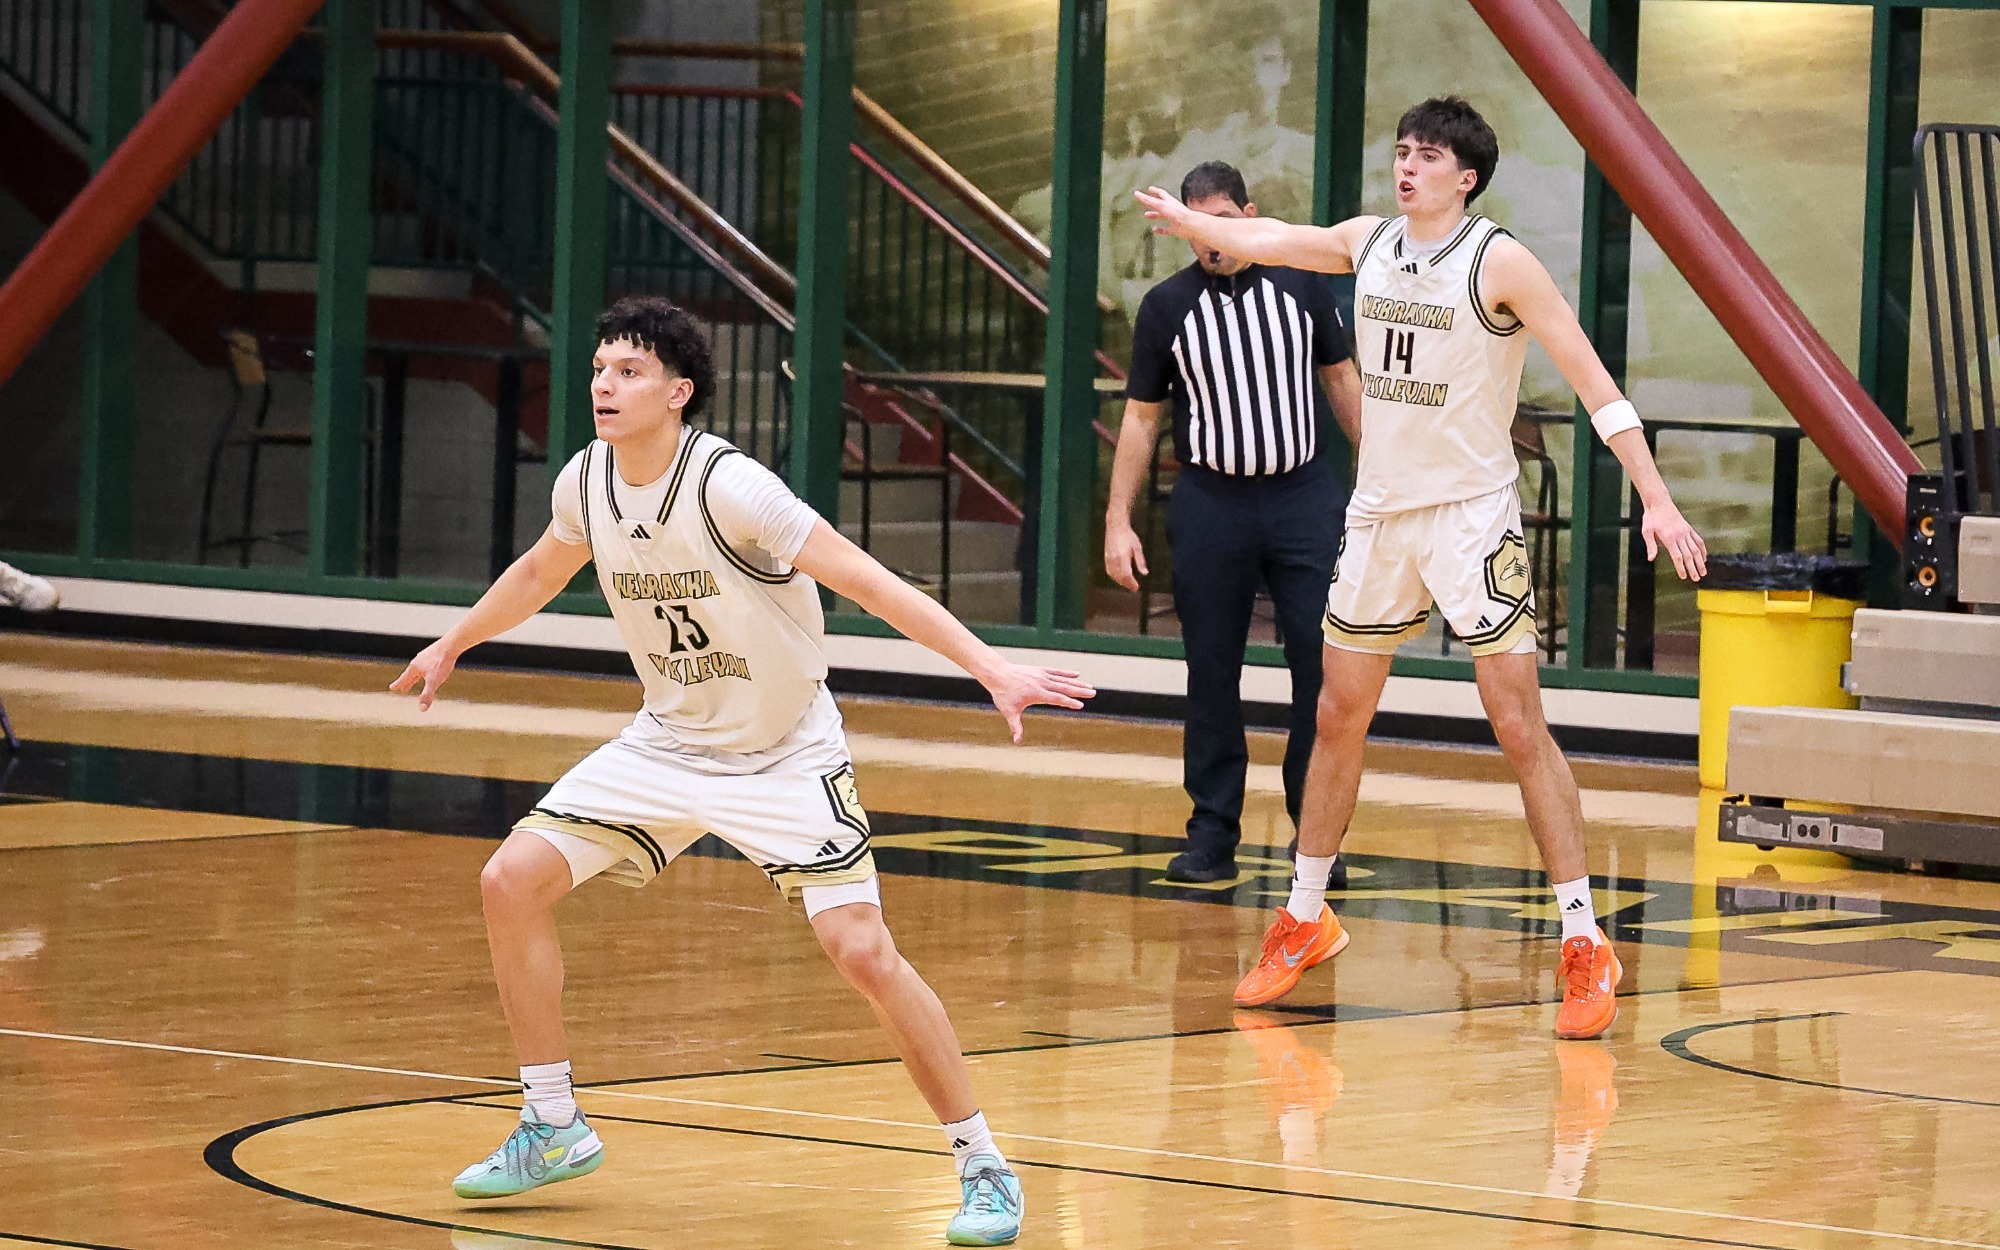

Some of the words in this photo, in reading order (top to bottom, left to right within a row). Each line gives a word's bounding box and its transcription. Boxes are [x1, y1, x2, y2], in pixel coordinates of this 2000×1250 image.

[1361, 294, 1455, 331] NEBRASKA
[1383, 327, 1415, 375] 14
[1363, 373, 1449, 407] ESLEYAN
[612, 570, 721, 601] NEBRASKA
[654, 604, 710, 653] 23
